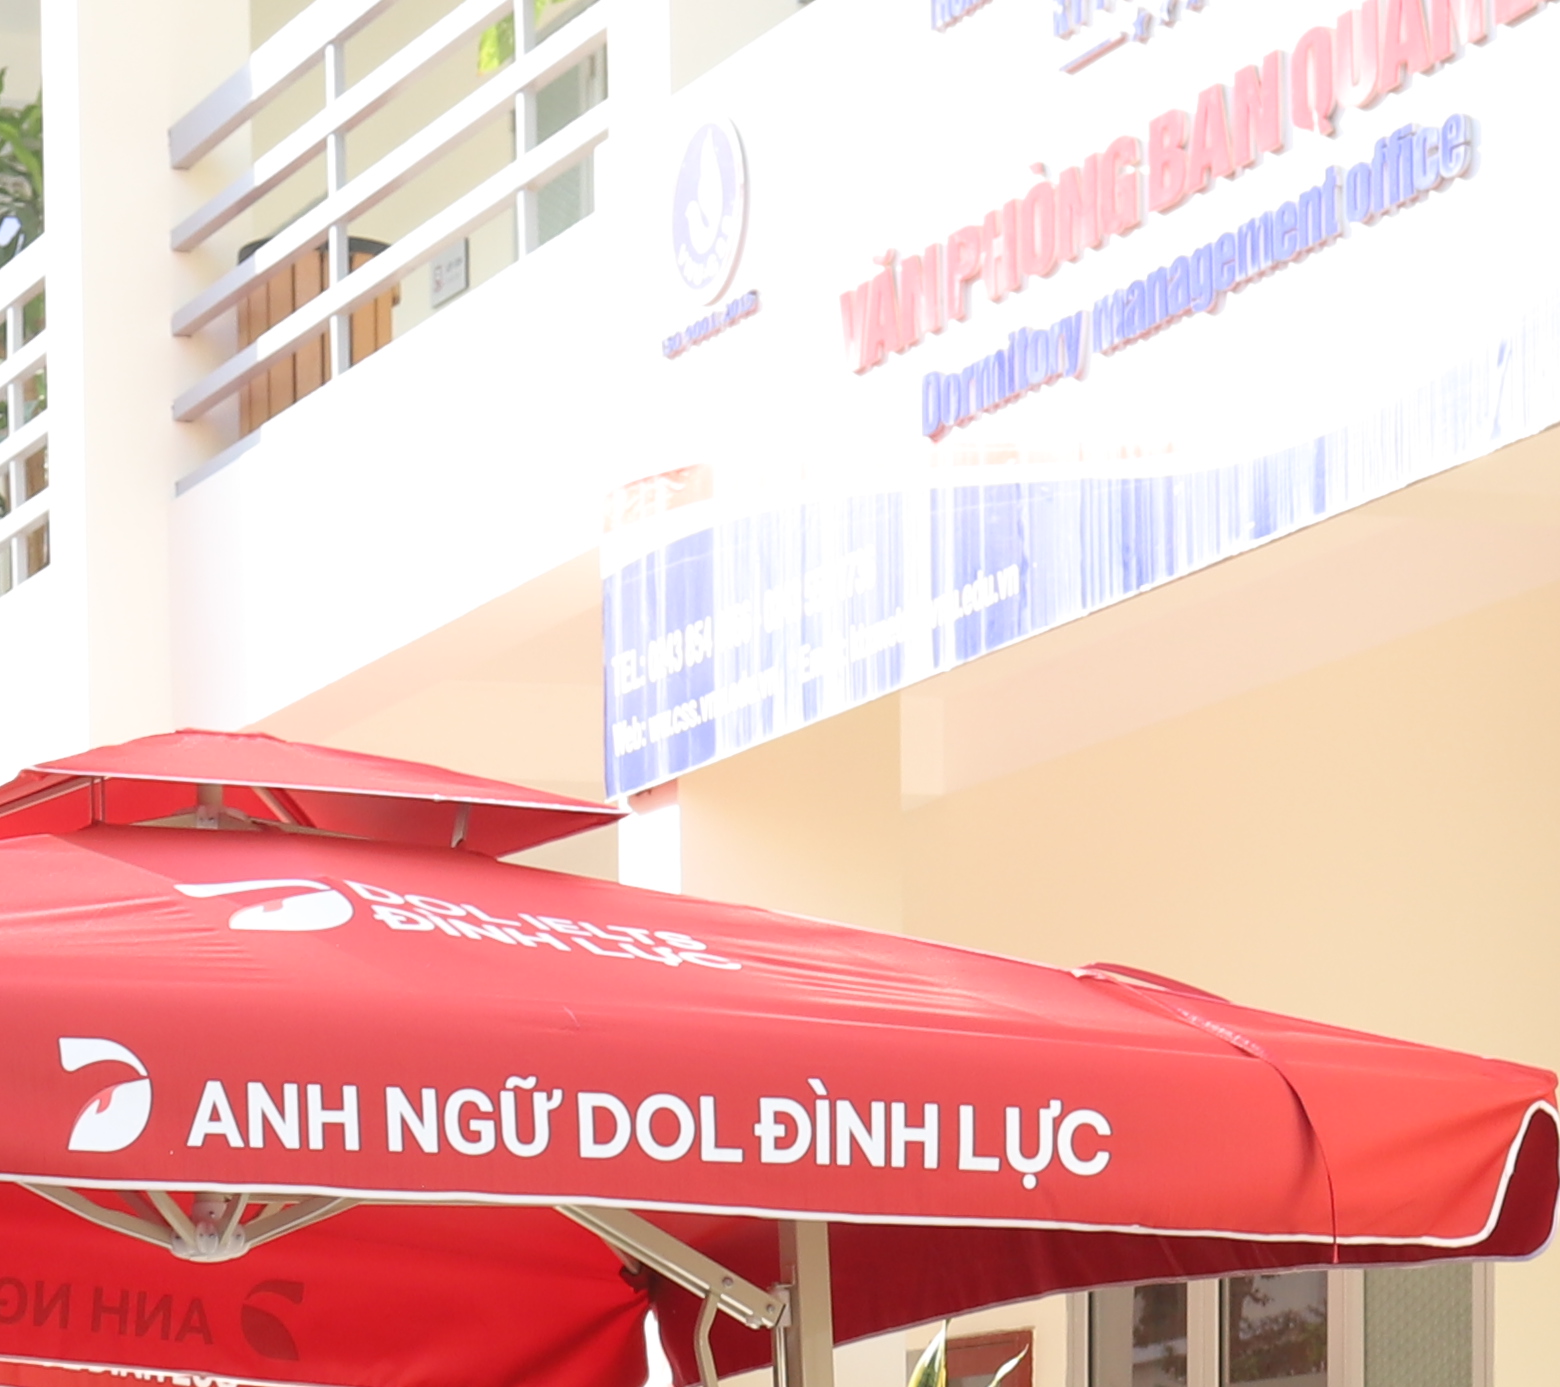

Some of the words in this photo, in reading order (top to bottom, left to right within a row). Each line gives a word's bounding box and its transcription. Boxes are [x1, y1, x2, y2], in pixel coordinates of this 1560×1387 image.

[1148, 50, 1286, 215] BAN
[921, 310, 1088, 443] Dormitory
[1092, 164, 1342, 357] management
[1345, 113, 1478, 227] office
[343, 880, 522, 927] DOL
[518, 913, 708, 951] IELTS
[186, 1078, 360, 1153] ANH
[385, 1076, 563, 1158] NGỮ
[577, 1092, 744, 1165] DOL
[753, 1079, 941, 1172] ĐÌNH
[957, 1099, 1113, 1191] LỰC
